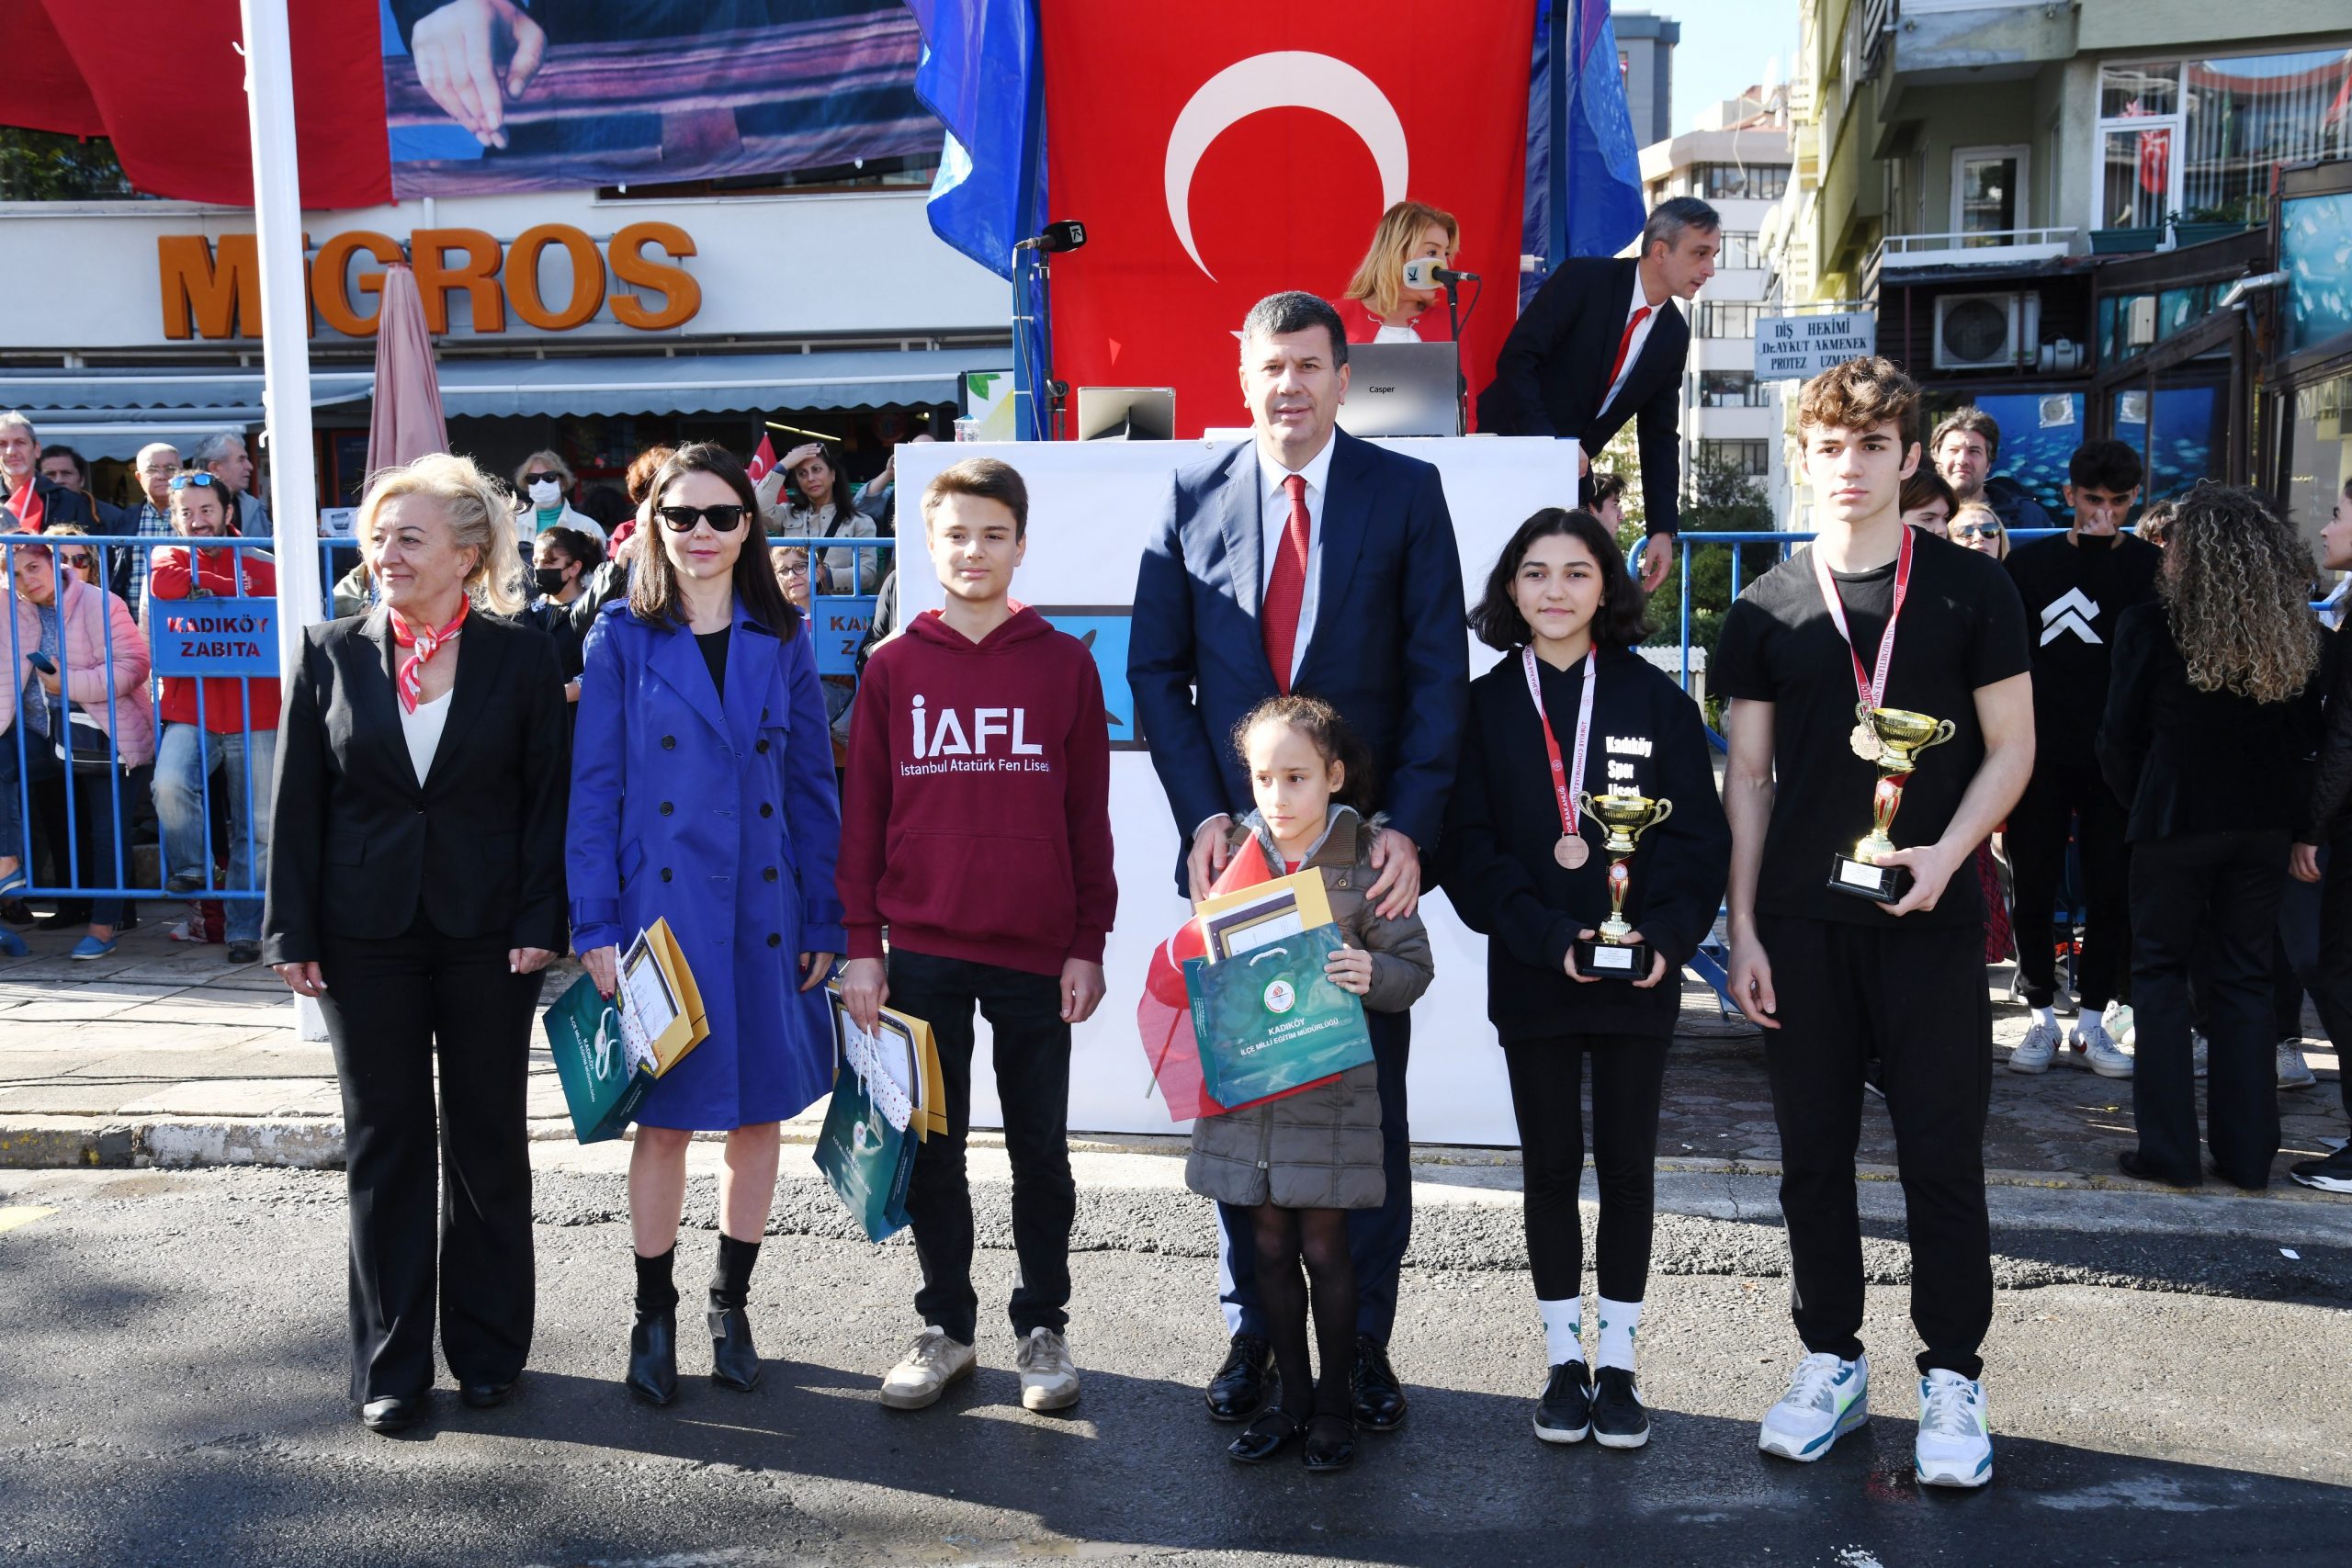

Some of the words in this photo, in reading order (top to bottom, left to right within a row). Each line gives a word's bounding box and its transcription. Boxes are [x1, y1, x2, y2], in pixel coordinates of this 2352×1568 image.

[158, 222, 702, 340] MGROS
[1775, 321, 1793, 339] DİŞ
[1808, 317, 1850, 335] HEKİMİ
[1762, 340, 1810, 354] Dr.AYKUT
[1815, 337, 1867, 351] AKMENEK
[1771, 356, 1807, 370] PROTEZ
[1369, 386, 1396, 395] Casper
[167, 615, 269, 633] KADIKÖY
[181, 642, 261, 658] ZABITA
[900, 760, 948, 776] İstanbul
[950, 758, 995, 773] Atatürk
[999, 759, 1021, 772] Fen
[1608, 760, 1634, 780] Spor
[1268, 1017, 1306, 1036] KADIKÖY
[1240, 1045, 1256, 1056] İLÇE
[1255, 1039, 1273, 1051] MİLLİ
[1273, 1032, 1297, 1044] EĞİTİM
